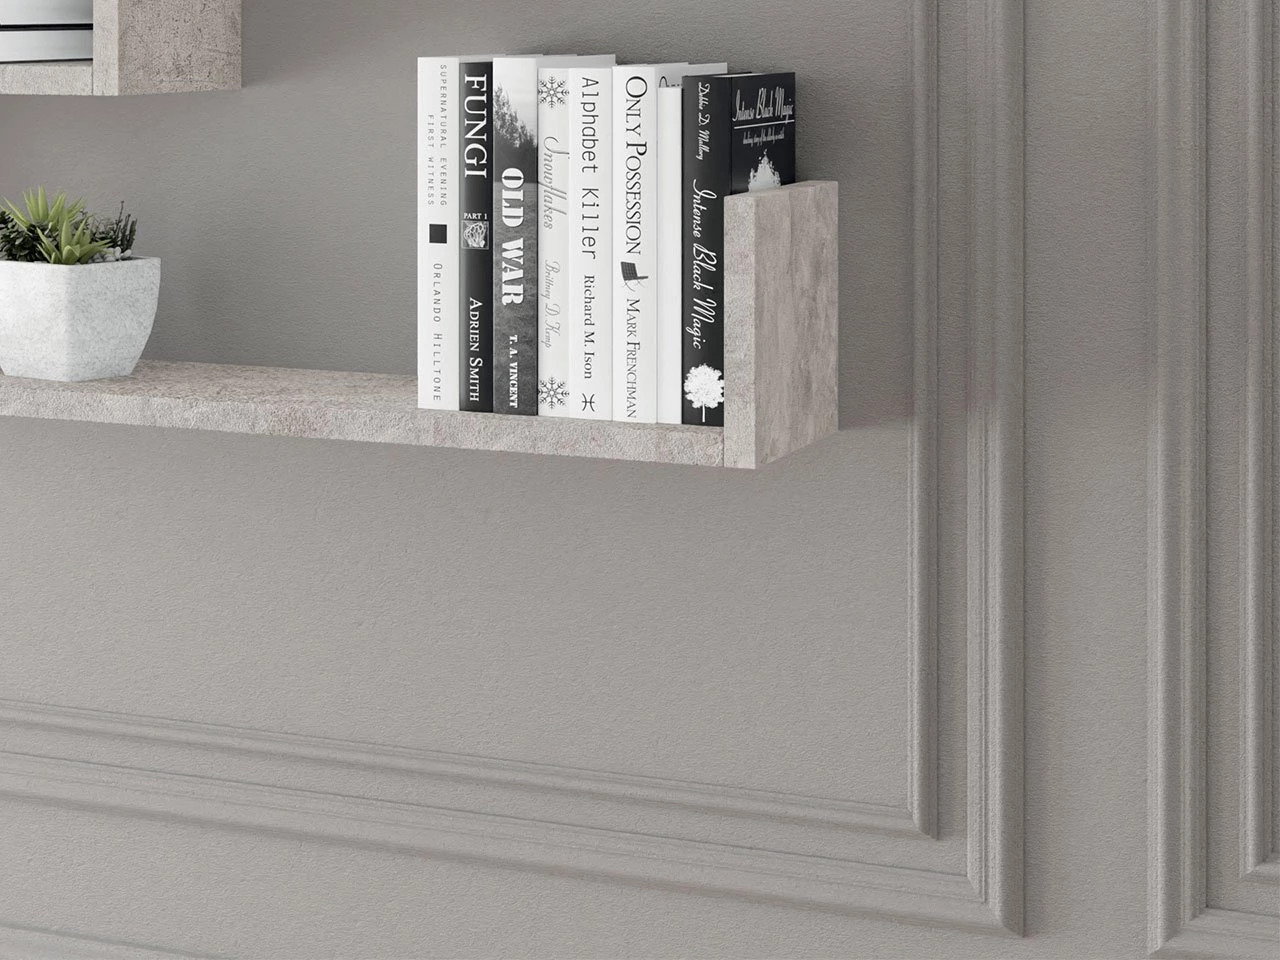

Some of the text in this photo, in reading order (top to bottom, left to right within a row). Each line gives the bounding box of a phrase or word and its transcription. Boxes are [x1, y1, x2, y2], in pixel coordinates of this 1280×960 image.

[427, 114, 435, 206] FIRST WITNESS
[440, 64, 448, 206] SUPERNATURAL EVENING
[464, 74, 487, 179] FUNGI
[581, 76, 600, 260] Alphabet Killer
[625, 76, 648, 256] ONLY POSSESSION
[696, 130, 710, 160] Mallory
[698, 112, 710, 127] D.
[463, 212, 482, 220] PART
[538, 136, 570, 230] Snowflakes
[501, 167, 524, 306] OLD WAR
[686, 178, 718, 350] Intense Black Magic
[433, 263, 443, 401] ORLANDO HILLTONE
[469, 297, 484, 402] ADRIEN SMITH
[509, 334, 518, 409] T. A. VINCENT
[541, 321, 561, 349] Kemp
[584, 275, 595, 379] Richard M. Ison
[626, 298, 641, 419] MARK FRENCHMAN
